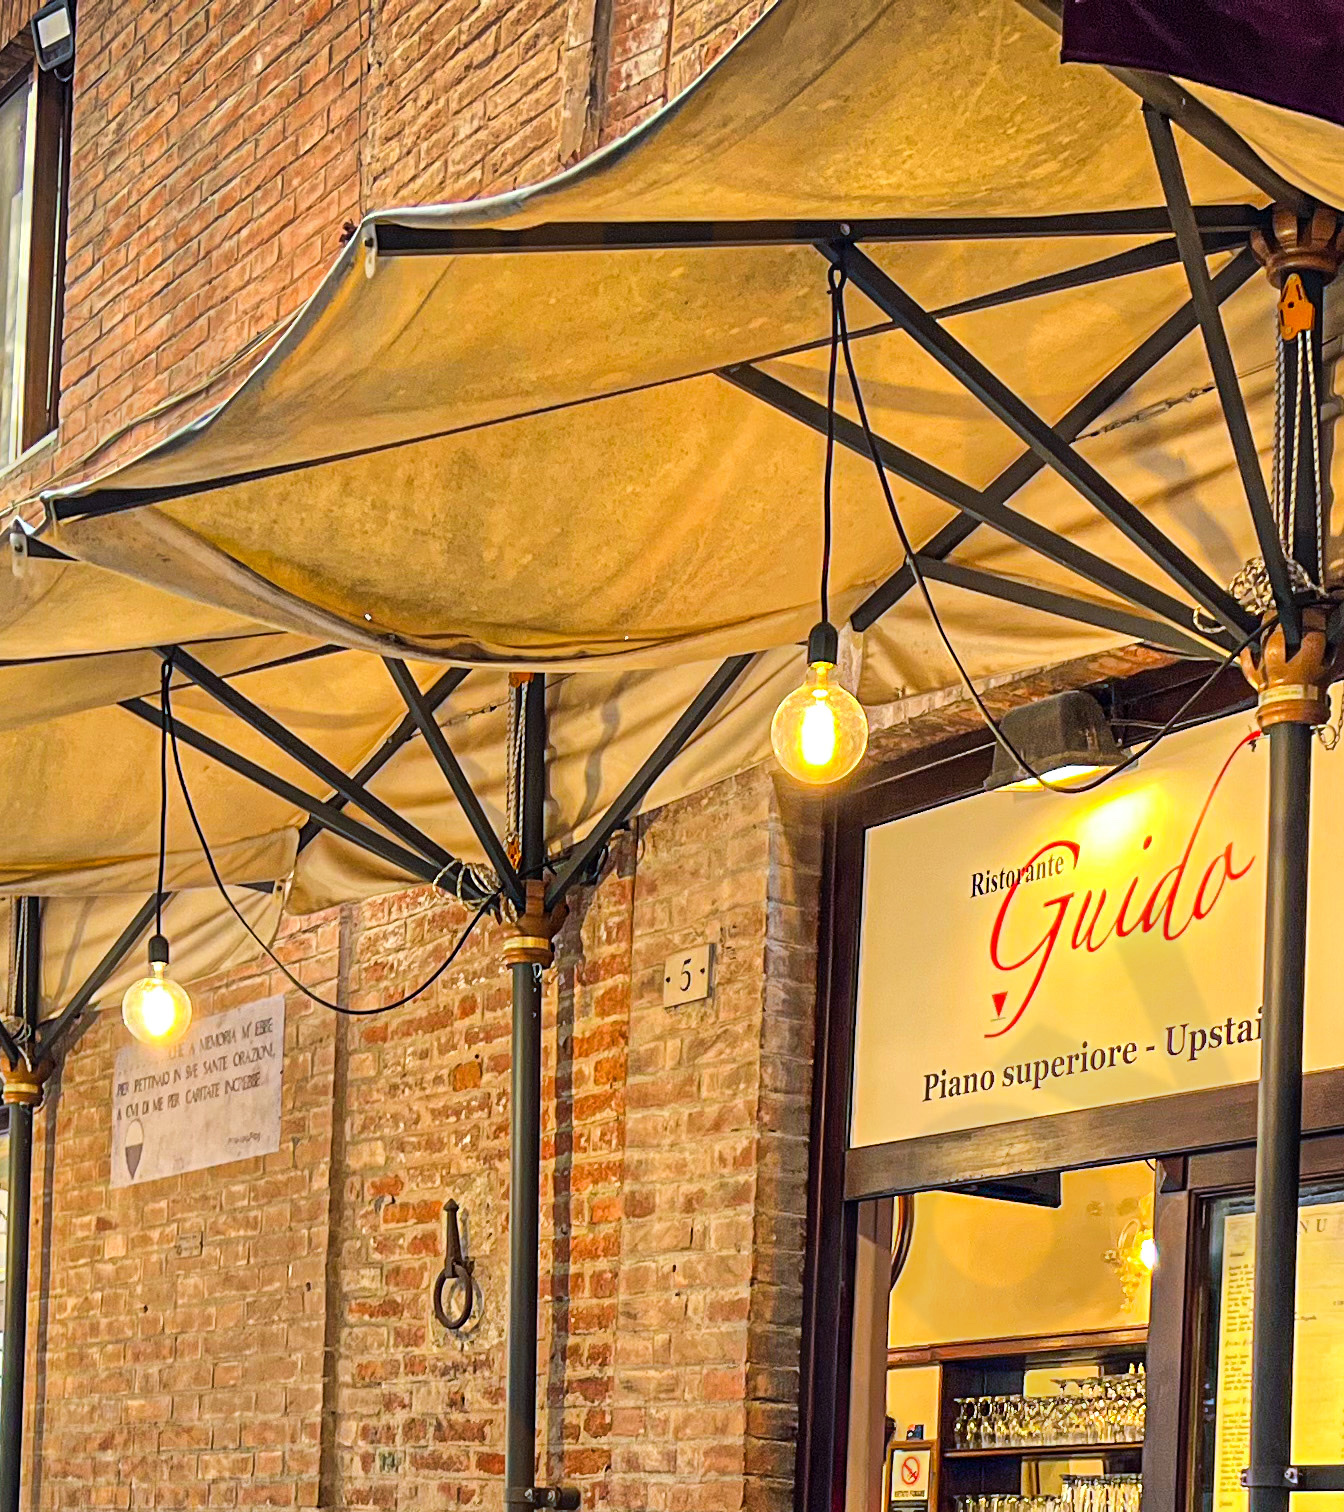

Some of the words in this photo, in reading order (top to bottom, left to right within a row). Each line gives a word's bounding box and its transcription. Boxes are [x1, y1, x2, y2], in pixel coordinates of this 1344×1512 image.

[970, 853, 1064, 898] Ristorante
[984, 730, 1262, 1038] Guido
[680, 958, 692, 991] 5
[922, 1069, 995, 1102] Piano
[1001, 1041, 1138, 1090] superiore
[1165, 1007, 1263, 1061] Upstai
[1299, 1218, 1328, 1234] NU
